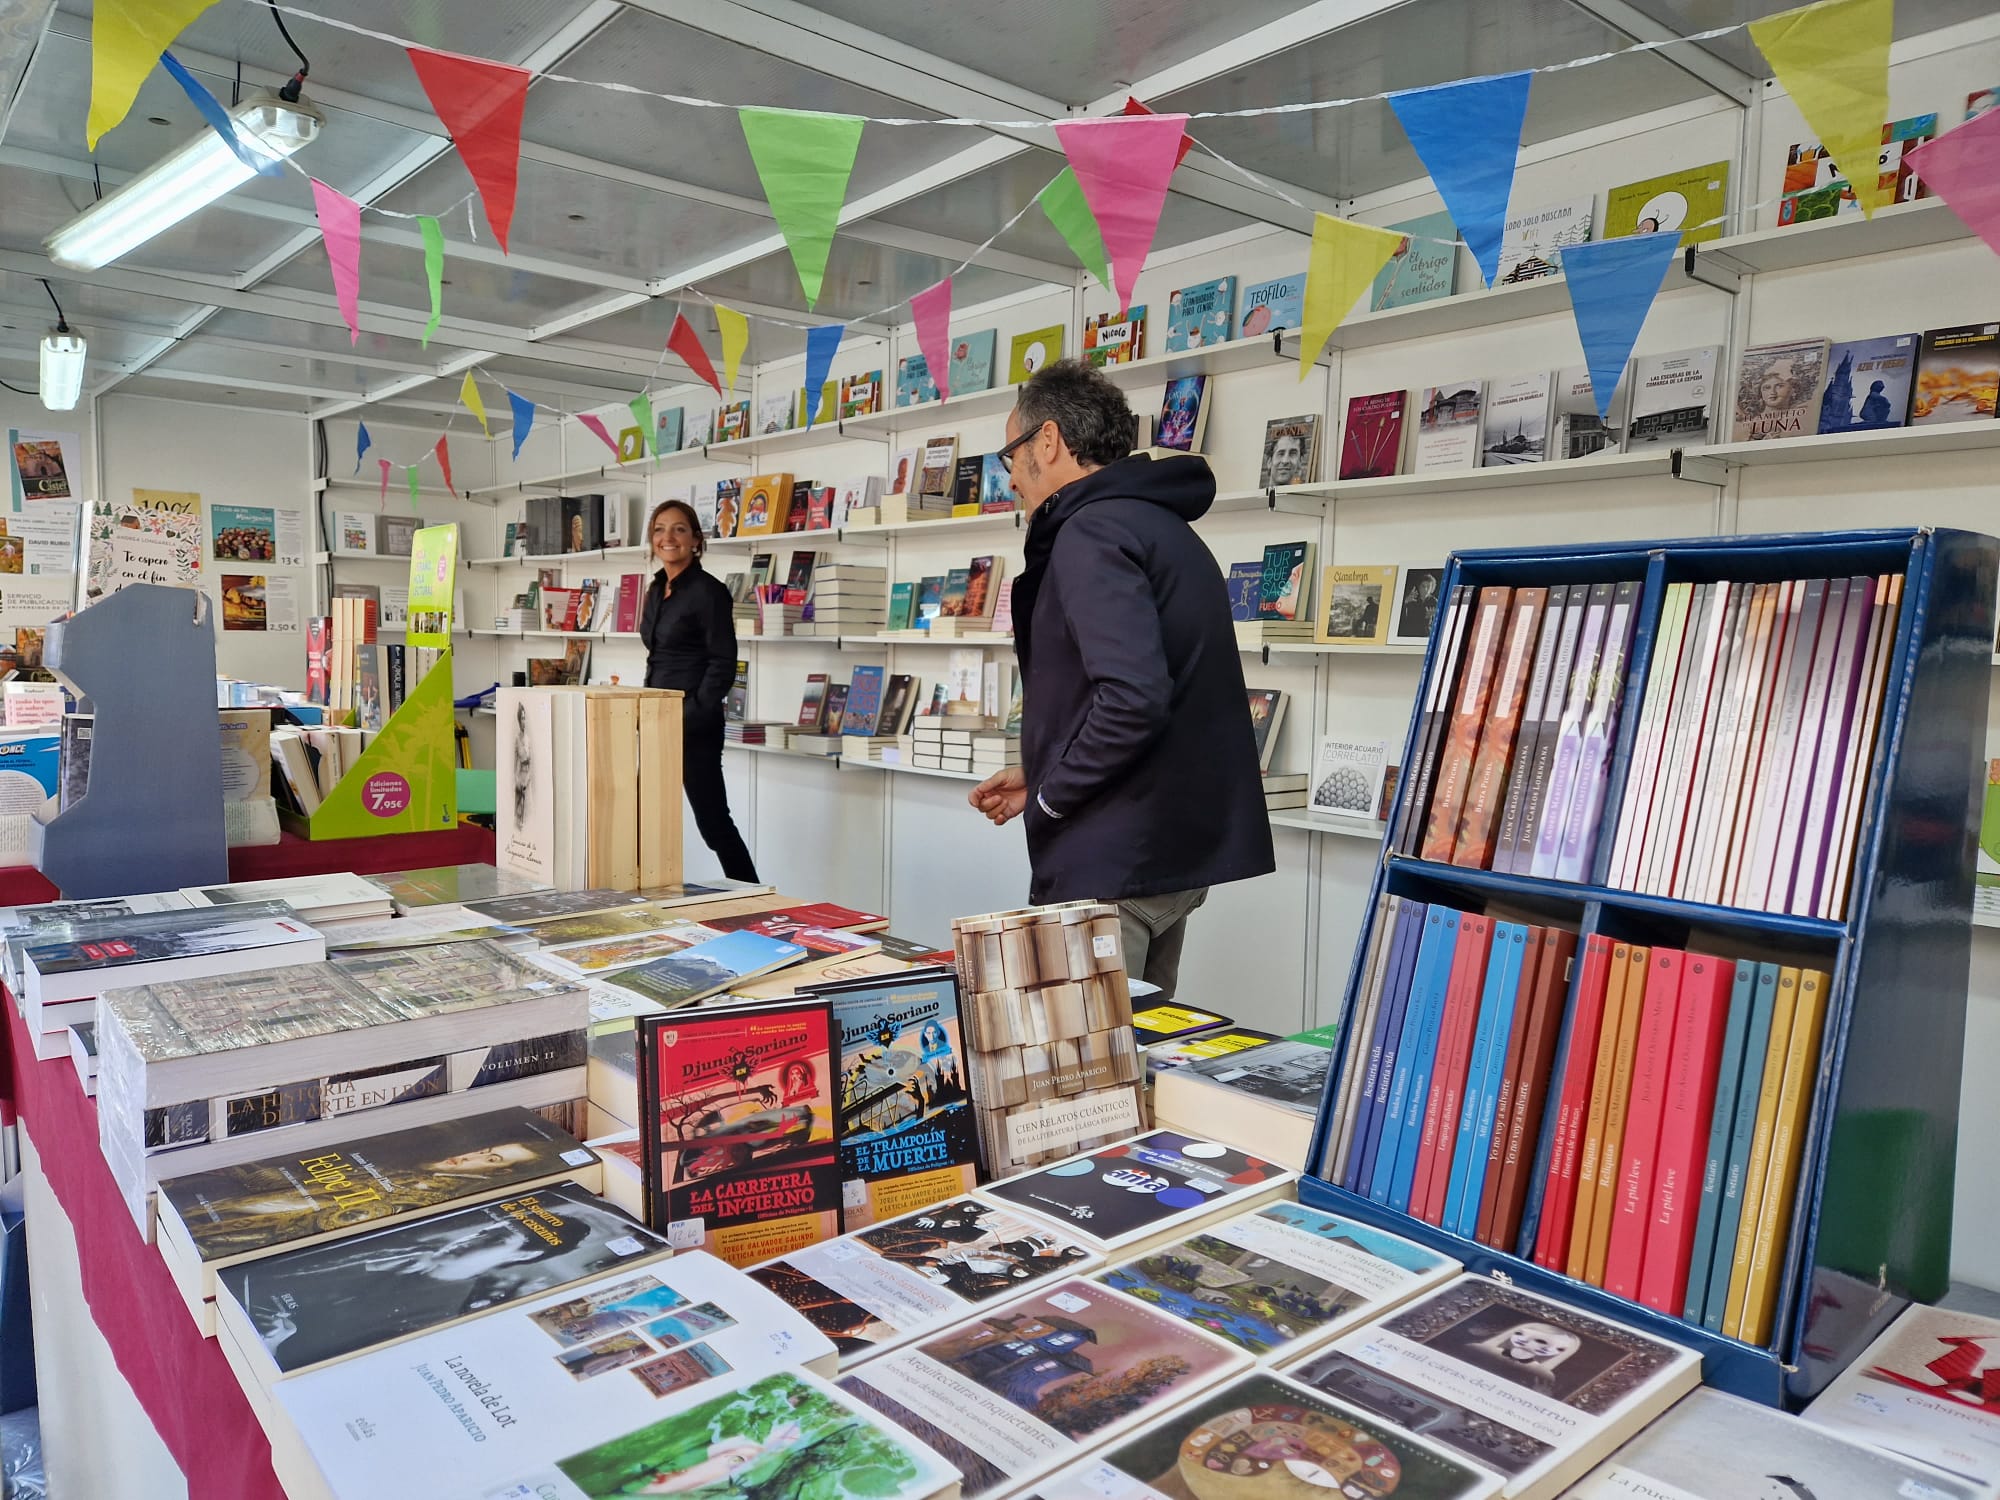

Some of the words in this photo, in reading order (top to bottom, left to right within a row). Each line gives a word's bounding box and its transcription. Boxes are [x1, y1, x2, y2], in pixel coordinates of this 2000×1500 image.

[1523, 214, 1539, 229] SOLO
[1541, 207, 1572, 224] BUSCABA
[1408, 251, 1420, 263] El
[1411, 256, 1448, 273] abrigo
[1401, 280, 1447, 297] sentidos
[1646, 379, 1669, 388] COMARCA
[1660, 371, 1684, 380] ESCUELAS
[1752, 419, 1800, 434] LUNA
[117, 535, 139, 544] ANDREA
[123, 551, 135, 562] Te
[138, 555, 168, 567] espero
[281, 557, 292, 565] 13
[1266, 551, 1290, 567] TUR
[122, 571, 134, 579] en
[138, 570, 148, 580] el
[151, 570, 167, 583] fin
[1263, 568, 1287, 582] QUE
[1261, 581, 1292, 597] SAS
[1325, 743, 1353, 751] INTERIOR
[1354, 745, 1383, 753] ACUARIO
[1481, 763, 1493, 789] PICHEL
[1513, 745, 1529, 789] LORENZANA
[1533, 746, 1549, 790] LORENZANA
[1404, 782, 1415, 806] BRUNO
[1410, 752, 1422, 781] MARCOS
[1416, 782, 1427, 806] BRUNO
[1423, 752, 1433, 779] MARCOS
[371, 794, 402, 810] 7,95€
[1508, 790, 1519, 820] CARLOS
[1527, 791, 1538, 821] CARLOS
[1504, 821, 1513, 842] JUAN
[1523, 823, 1532, 843] JUAN
[888, 1001, 939, 1027] Soriano
[480, 1054, 540, 1072] VOLUMEN
[544, 1050, 556, 1062] II
[683, 1053, 733, 1077] Djuna
[744, 1033, 808, 1057] Soriano
[1372, 1046, 1382, 1063] vida
[1385, 1051, 1395, 1069] vida
[1032, 1079, 1050, 1091] JUAN
[1052, 1073, 1074, 1084] PEDRO
[1075, 1066, 1107, 1079] APARICIO
[229, 1100, 254, 1115] LA
[263, 1080, 356, 1107] HISTORIA
[1499, 1078, 1512, 1110] salvarte
[1518, 1081, 1530, 1113] salvarte
[263, 1107, 295, 1126] DEL
[307, 1095, 356, 1117] ARTE
[362, 1090, 386, 1106] EN
[1016, 1121, 1038, 1135] CIEN
[1040, 1111, 1078, 1129] RELATOS
[1080, 1099, 1129, 1118] CUÁNTICOS
[1037, 1126, 1074, 1141] LITERATURA
[1101, 1112, 1131, 1124] ESPAÑOLA
[1495, 1118, 1505, 1136] voy
[1513, 1121, 1525, 1140] voy
[1556, 1136, 1563, 1150] de
[1560, 1123, 1567, 1135] un
[1570, 1127, 1577, 1138] un
[856, 1146, 869, 1157] EL
[871, 1128, 946, 1151] TRAMPOLÍN
[1493, 1135, 1500, 1149] no
[1510, 1139, 1518, 1152] no
[1567, 1139, 1574, 1152] de
[857, 1157, 869, 1165] DE
[858, 1164, 870, 1172] LA
[871, 1143, 948, 1174] MUERTE
[1489, 1148, 1499, 1162] Yo
[1505, 1152, 1517, 1166] Yo
[1562, 1153, 1573, 1178] Historia
[1583, 1138, 1596, 1181] Reliquias
[1600, 1144, 1614, 1188] Reliquias
[1632, 1158, 1641, 1179] leve
[1667, 1168, 1677, 1189] leve
[299, 1152, 352, 1191] Felipe
[333, 1187, 381, 1209] II
[690, 1191, 713, 1204] LA
[716, 1171, 814, 1200] CARRETERA
[1630, 1180, 1639, 1202] piel
[1727, 1163, 1740, 1199] Bestiario
[1747, 1160, 1763, 1223] comportamiento
[519, 1197, 534, 1211] El
[530, 1203, 565, 1227] susurro
[690, 1203, 715, 1215] DEL
[717, 1188, 815, 1218] INFIERNO
[1626, 1201, 1636, 1214] La
[1664, 1190, 1674, 1213] piel
[501, 1201, 516, 1211] de
[511, 1209, 528, 1221] los
[523, 1217, 563, 1246] castaños
[1660, 1212, 1671, 1225] La
[1743, 1224, 1751, 1237] de
[723, 1244, 743, 1253] JORGE
[786, 1232, 814, 1243] GALINDO
[1737, 1239, 1750, 1266] Manual
[1756, 1244, 1769, 1272] Manual
[1763, 1231, 1771, 1243] de
[728, 1252, 754, 1262] LETICIA
[444, 1355, 463, 1369] La
[454, 1368, 491, 1397] novela
[480, 1394, 502, 1409] de
[491, 1405, 518, 1428] Lot
[1375, 1338, 1398, 1354] Las
[1402, 1350, 1427, 1362] mil
[1428, 1362, 1466, 1381] caras
[1469, 1377, 1496, 1392] del
[1497, 1389, 1577, 1427] monstruo
[409, 1363, 434, 1383] JUAN
[429, 1378, 455, 1403] PEDRO
[448, 1403, 487, 1443] APARICIO
[903, 1355, 979, 1402] Arquitecturas
[979, 1398, 1059, 1450] inquietantes
[919, 1383, 930, 1392] de
[929, 1388, 955, 1407] relatos
[955, 1405, 966, 1414] de
[1608, 1472, 1629, 1486] La
